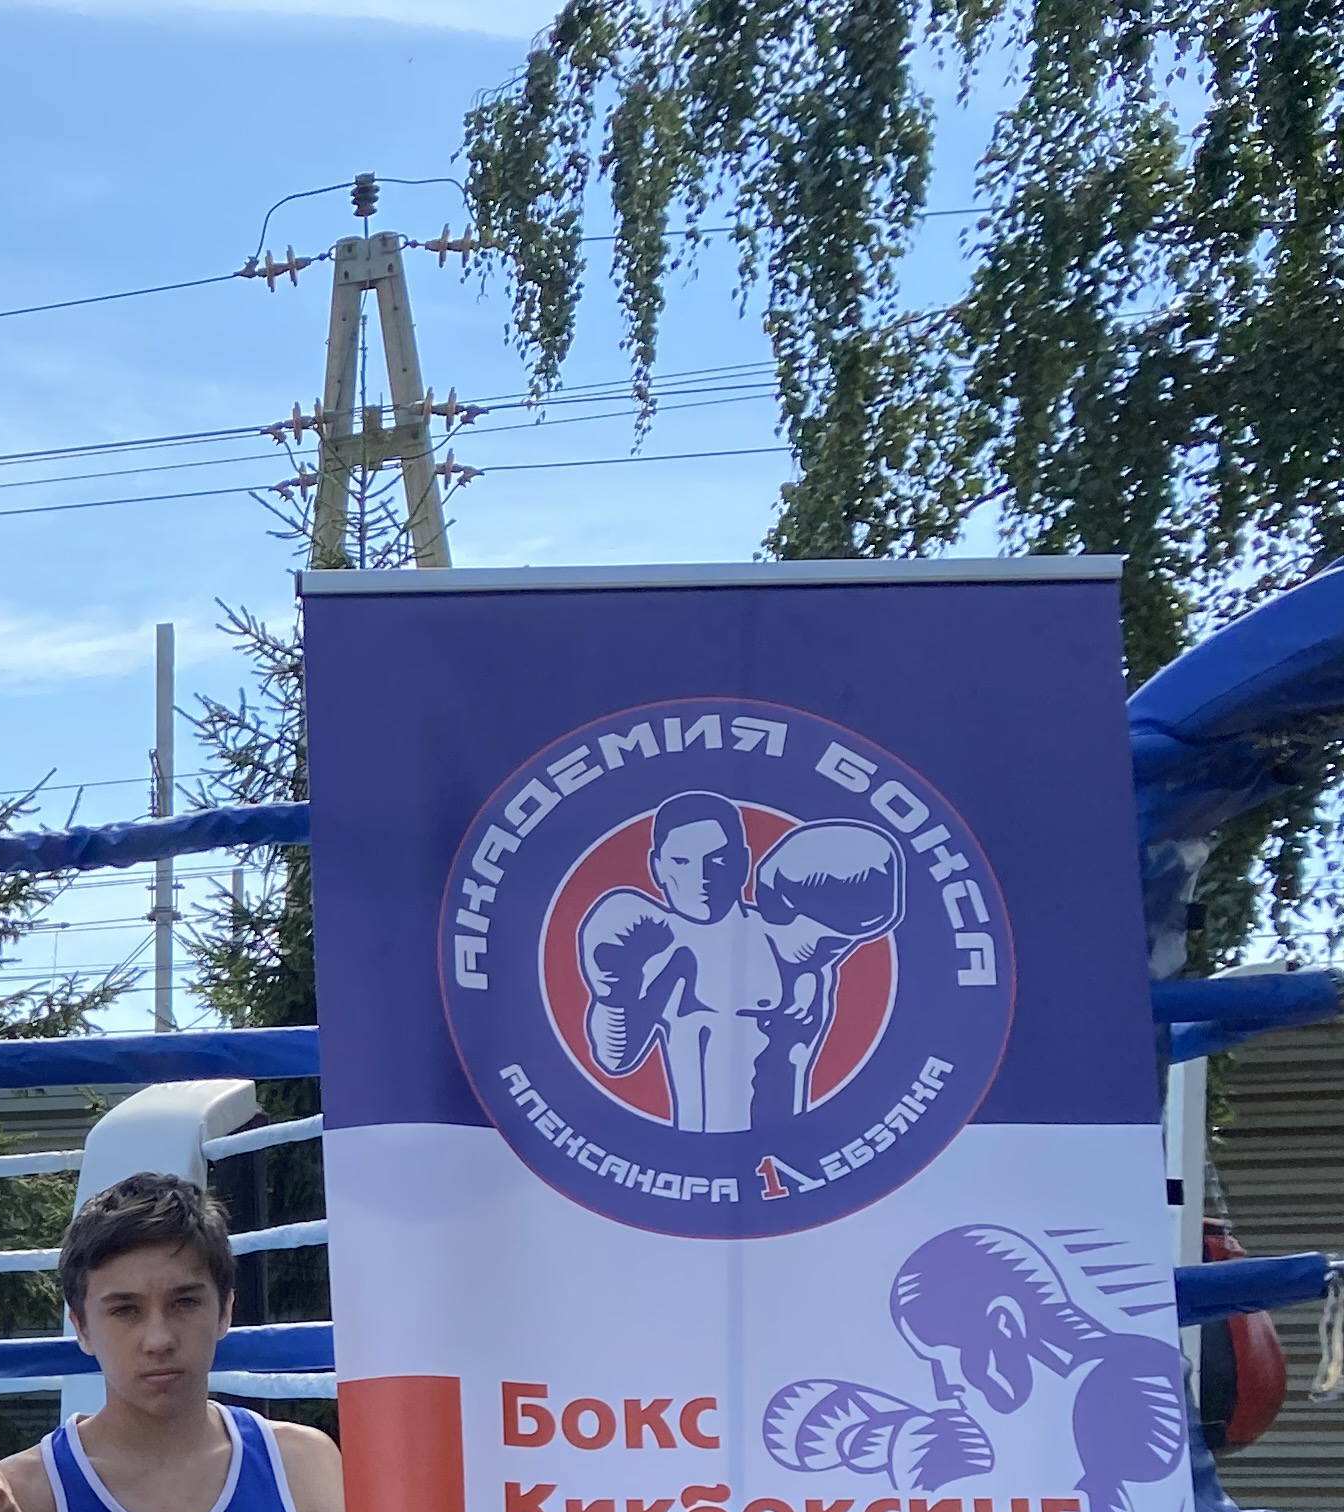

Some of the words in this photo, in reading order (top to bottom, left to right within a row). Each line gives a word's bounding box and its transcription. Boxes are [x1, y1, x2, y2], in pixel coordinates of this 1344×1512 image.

[454, 712, 790, 992] АКАДЕМИЯ
[814, 740, 999, 988] БОКСА
[499, 1062, 739, 1204] АЛЕКСАНДРА
[502, 1381, 720, 1450] Бокс
